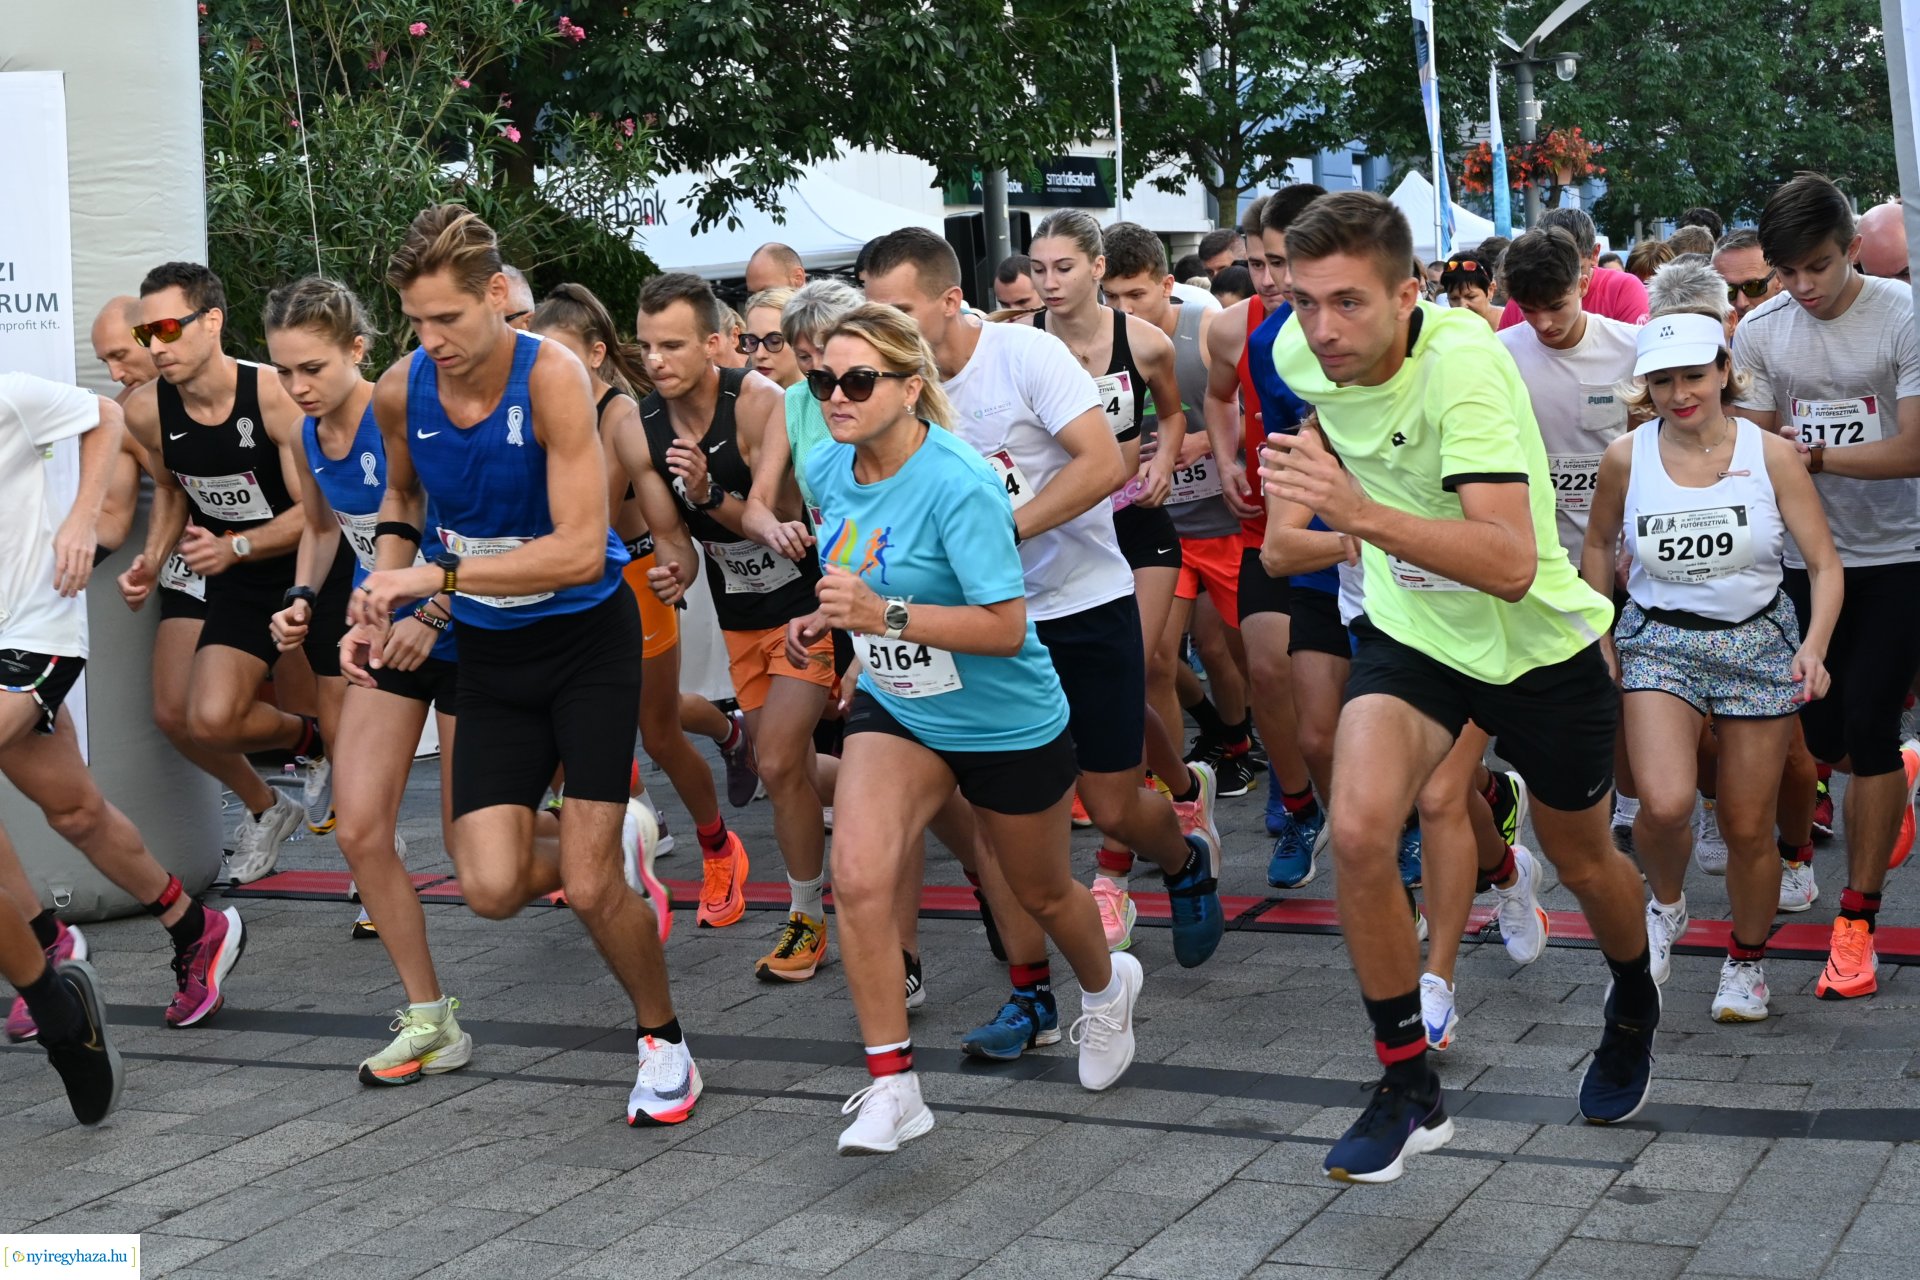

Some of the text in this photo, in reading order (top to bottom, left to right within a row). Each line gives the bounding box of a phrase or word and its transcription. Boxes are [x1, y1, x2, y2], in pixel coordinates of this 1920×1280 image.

[615, 189, 668, 226] Bank
[0, 292, 59, 313] RUM
[40, 320, 61, 330] Kft.
[1815, 408, 1860, 418] FUTÓFESZTIVÁL
[1801, 421, 1865, 446] 5172
[1563, 461, 1600, 470] FUTÓFESZTIVÁ
[198, 489, 251, 506] 5030
[1680, 518, 1730, 530] FUTÓFESZTIVÁL
[352, 531, 376, 556] 50
[1658, 532, 1733, 562] 5209
[725, 551, 776, 577] 5064
[869, 643, 932, 671] 5164
